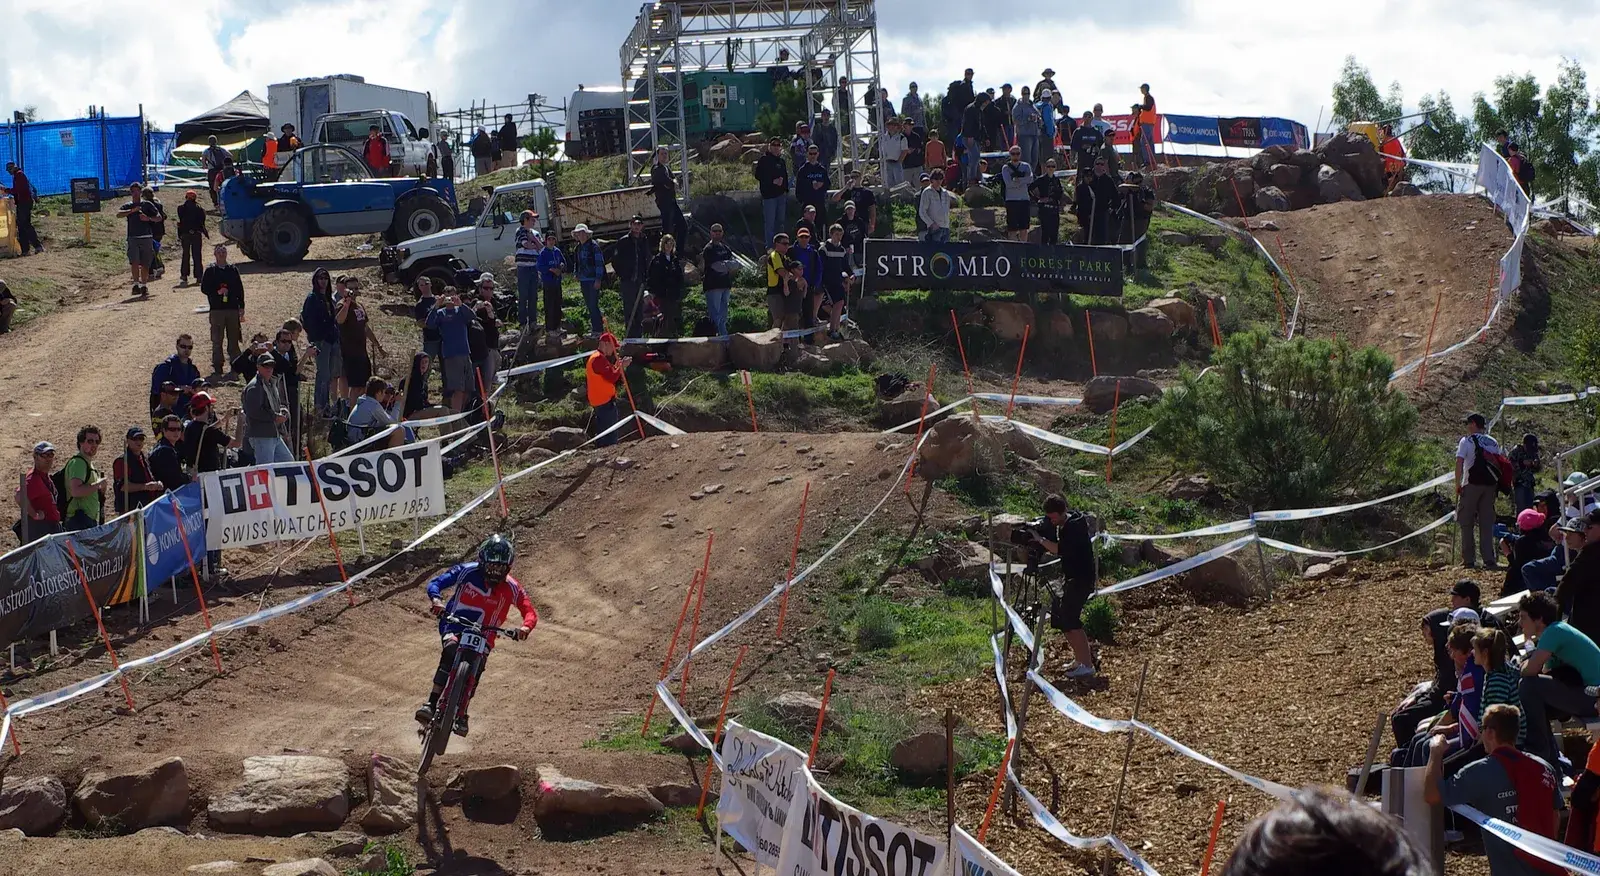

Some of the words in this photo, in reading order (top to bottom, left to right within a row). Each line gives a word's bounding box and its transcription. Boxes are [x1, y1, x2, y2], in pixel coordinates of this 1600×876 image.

[877, 252, 1011, 279] STROMLO
[1020, 257, 1072, 270] FOREST
[1079, 260, 1111, 273] PARK
[273, 447, 428, 506] TISSOT
[222, 520, 268, 544] SWISS
[273, 510, 347, 536] WATCHES
[353, 502, 397, 524] SINCE
[402, 496, 431, 516] 1853
[467, 634, 480, 646] 18
